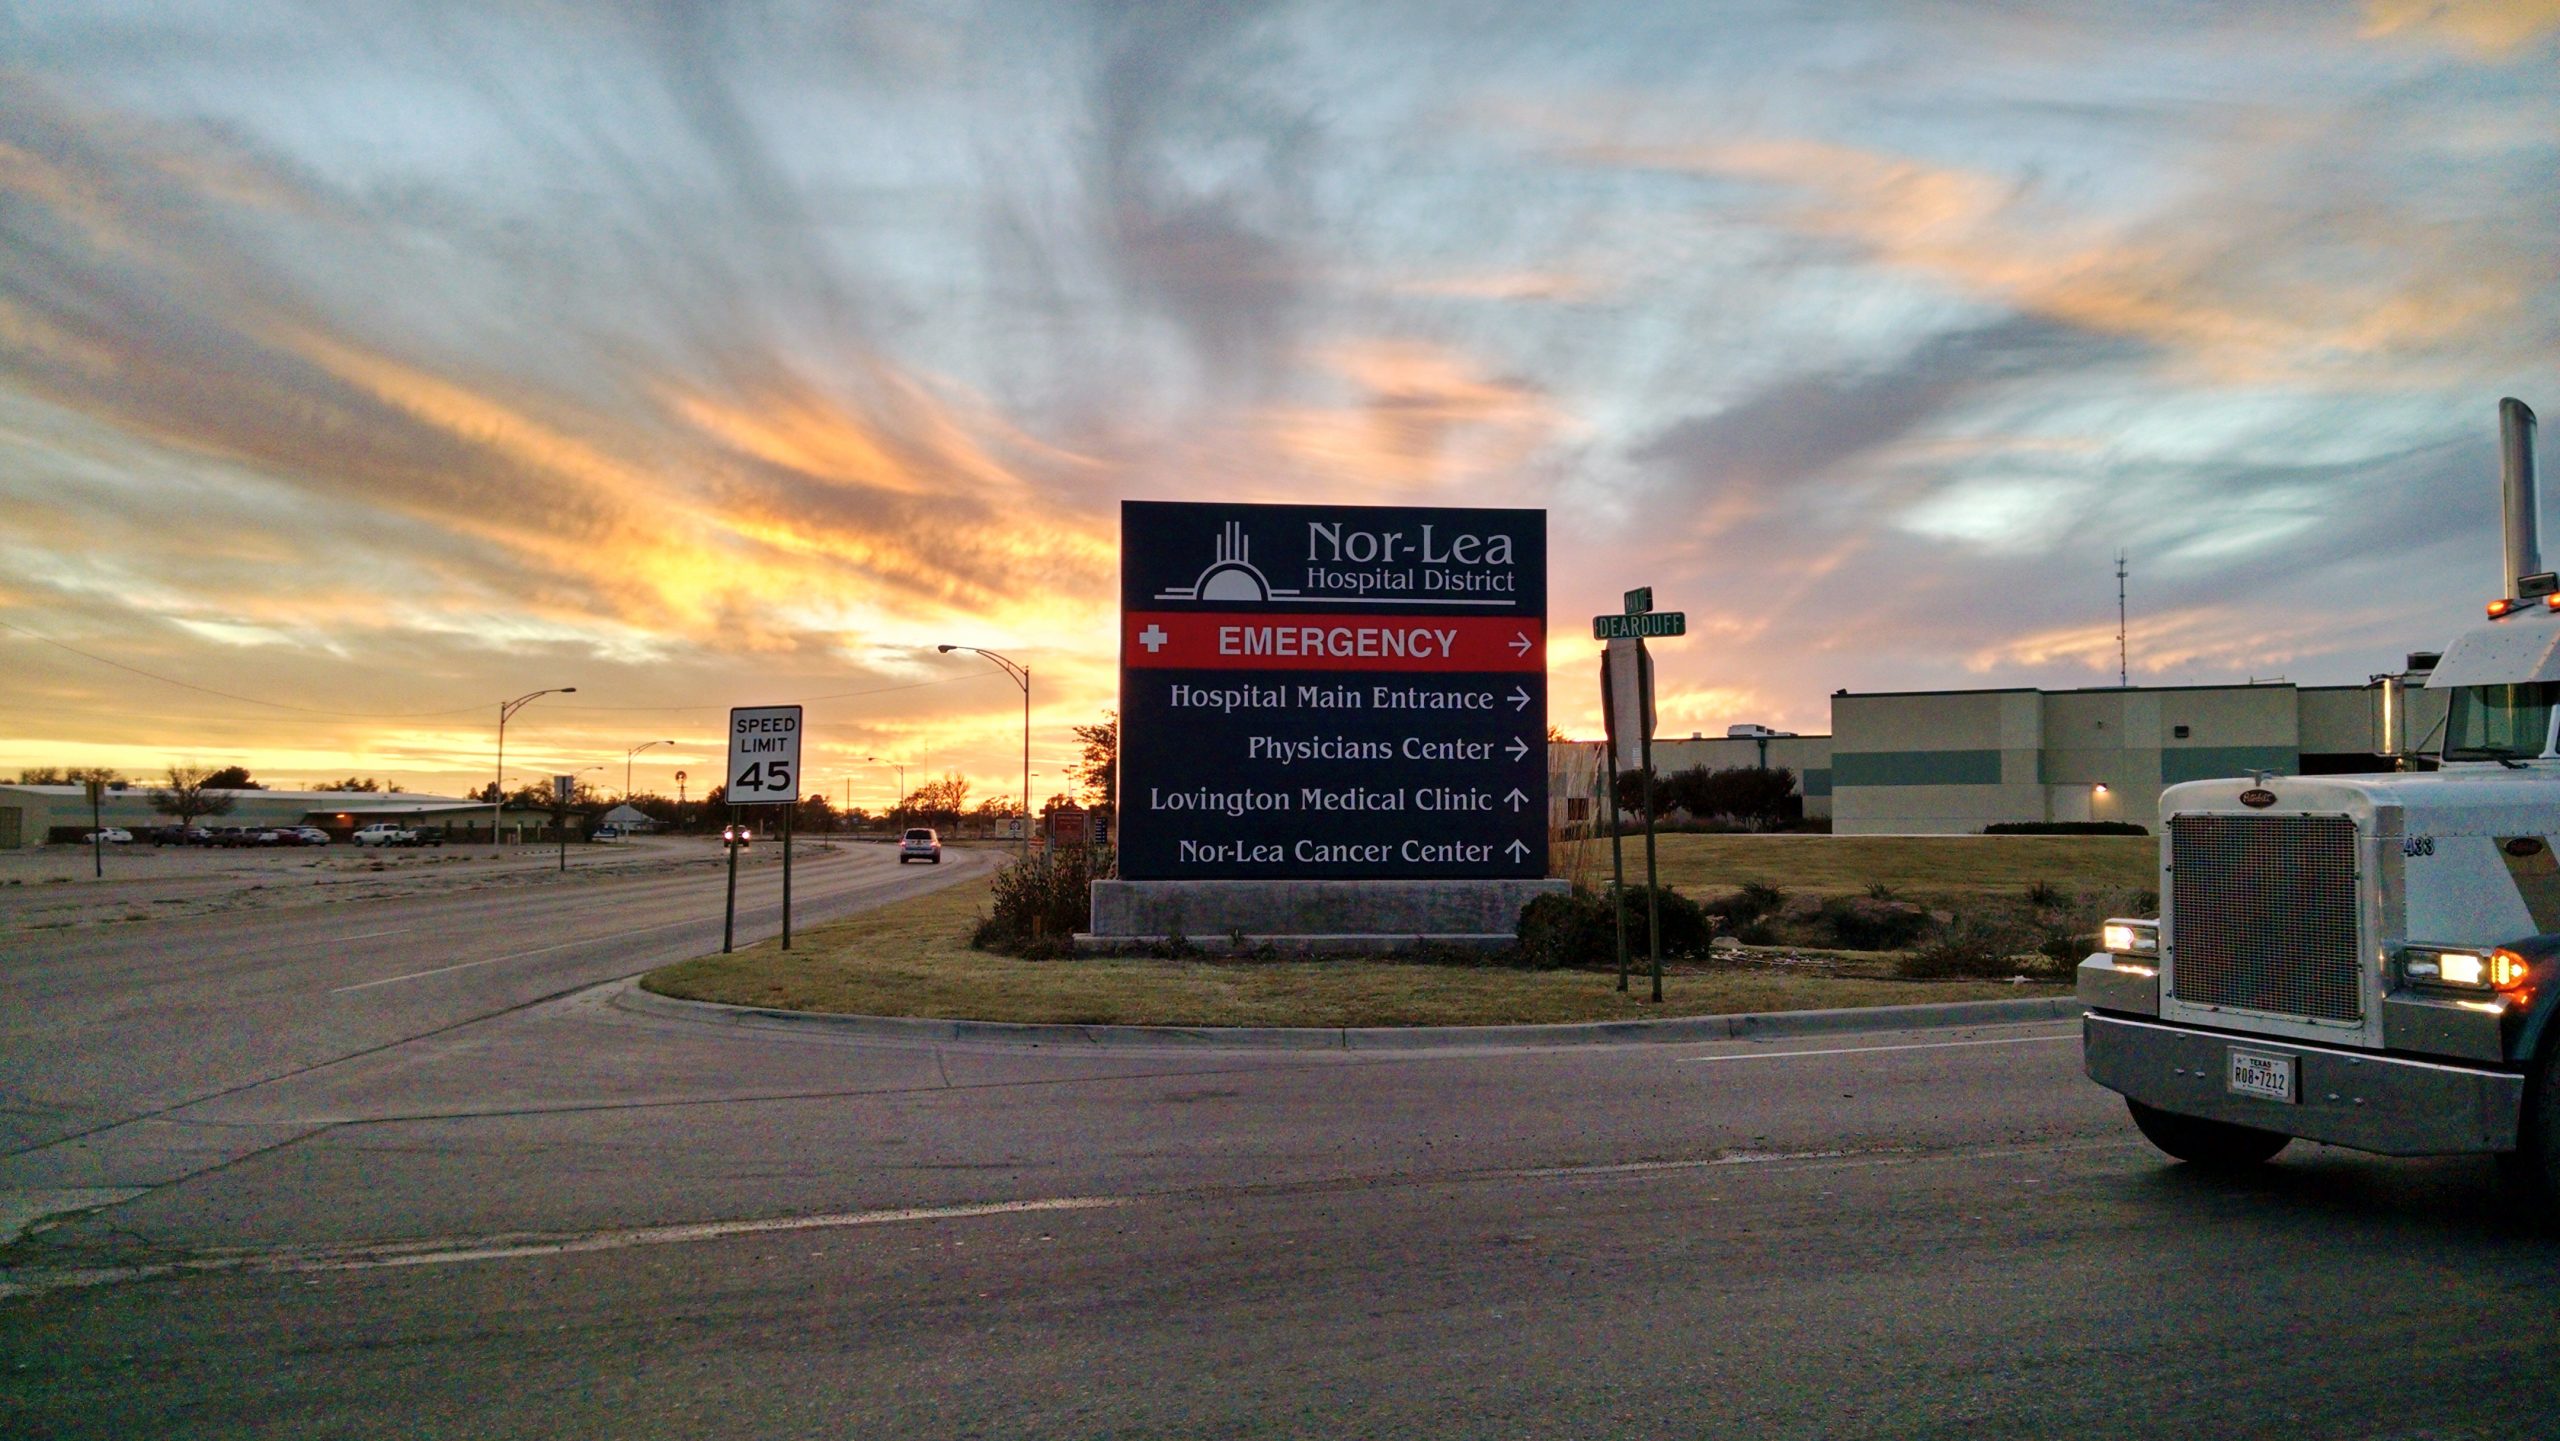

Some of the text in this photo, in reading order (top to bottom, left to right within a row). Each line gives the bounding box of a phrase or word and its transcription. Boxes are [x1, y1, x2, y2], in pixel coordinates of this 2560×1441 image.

[1308, 523, 1514, 565] Nor-Lea
[1308, 568, 1515, 594] Hospital District
[1599, 615, 1681, 637] DEARDUFF
[1219, 626, 1457, 657] EMERGENCY
[1171, 685, 1494, 713] Hospital Main Entrance
[736, 718, 795, 733] SPEED
[741, 738, 787, 752] LIMIT
[1249, 736, 1494, 764] Physicians Center
[736, 761, 791, 791] 45
[1151, 787, 1493, 816] Lovington Medical Clinic
[1179, 840, 1493, 863] Nor-Lea Cancer Center
[2249, 1058, 2272, 1068] TEXAS
